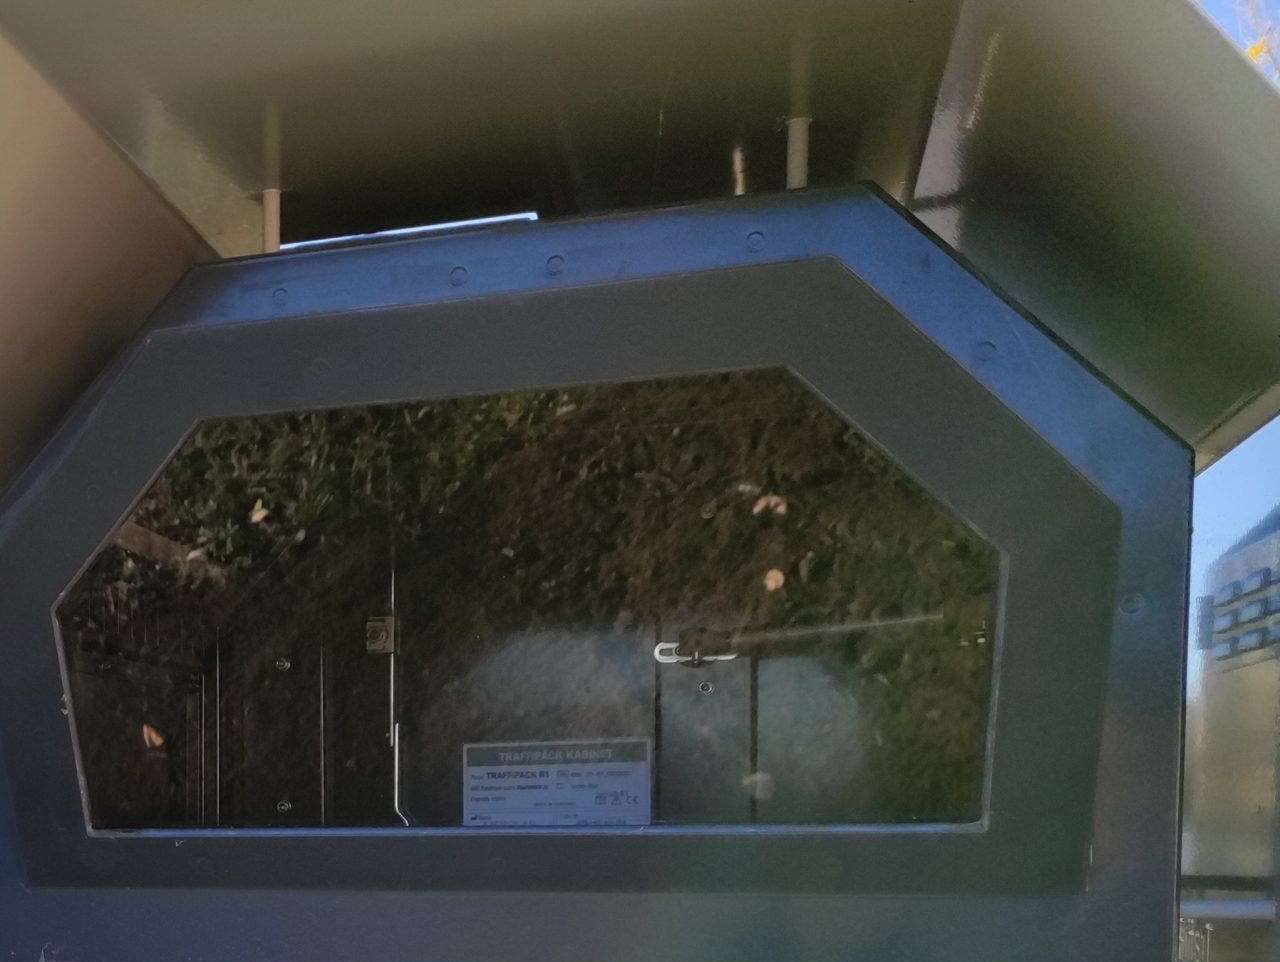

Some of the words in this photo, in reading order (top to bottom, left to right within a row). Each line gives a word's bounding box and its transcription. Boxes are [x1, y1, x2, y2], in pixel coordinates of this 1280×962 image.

[498, 750, 563, 762] TRAFFIPACK
[565, 749, 613, 760] KABINET
[486, 771, 537, 780] TRAFFIPACK
